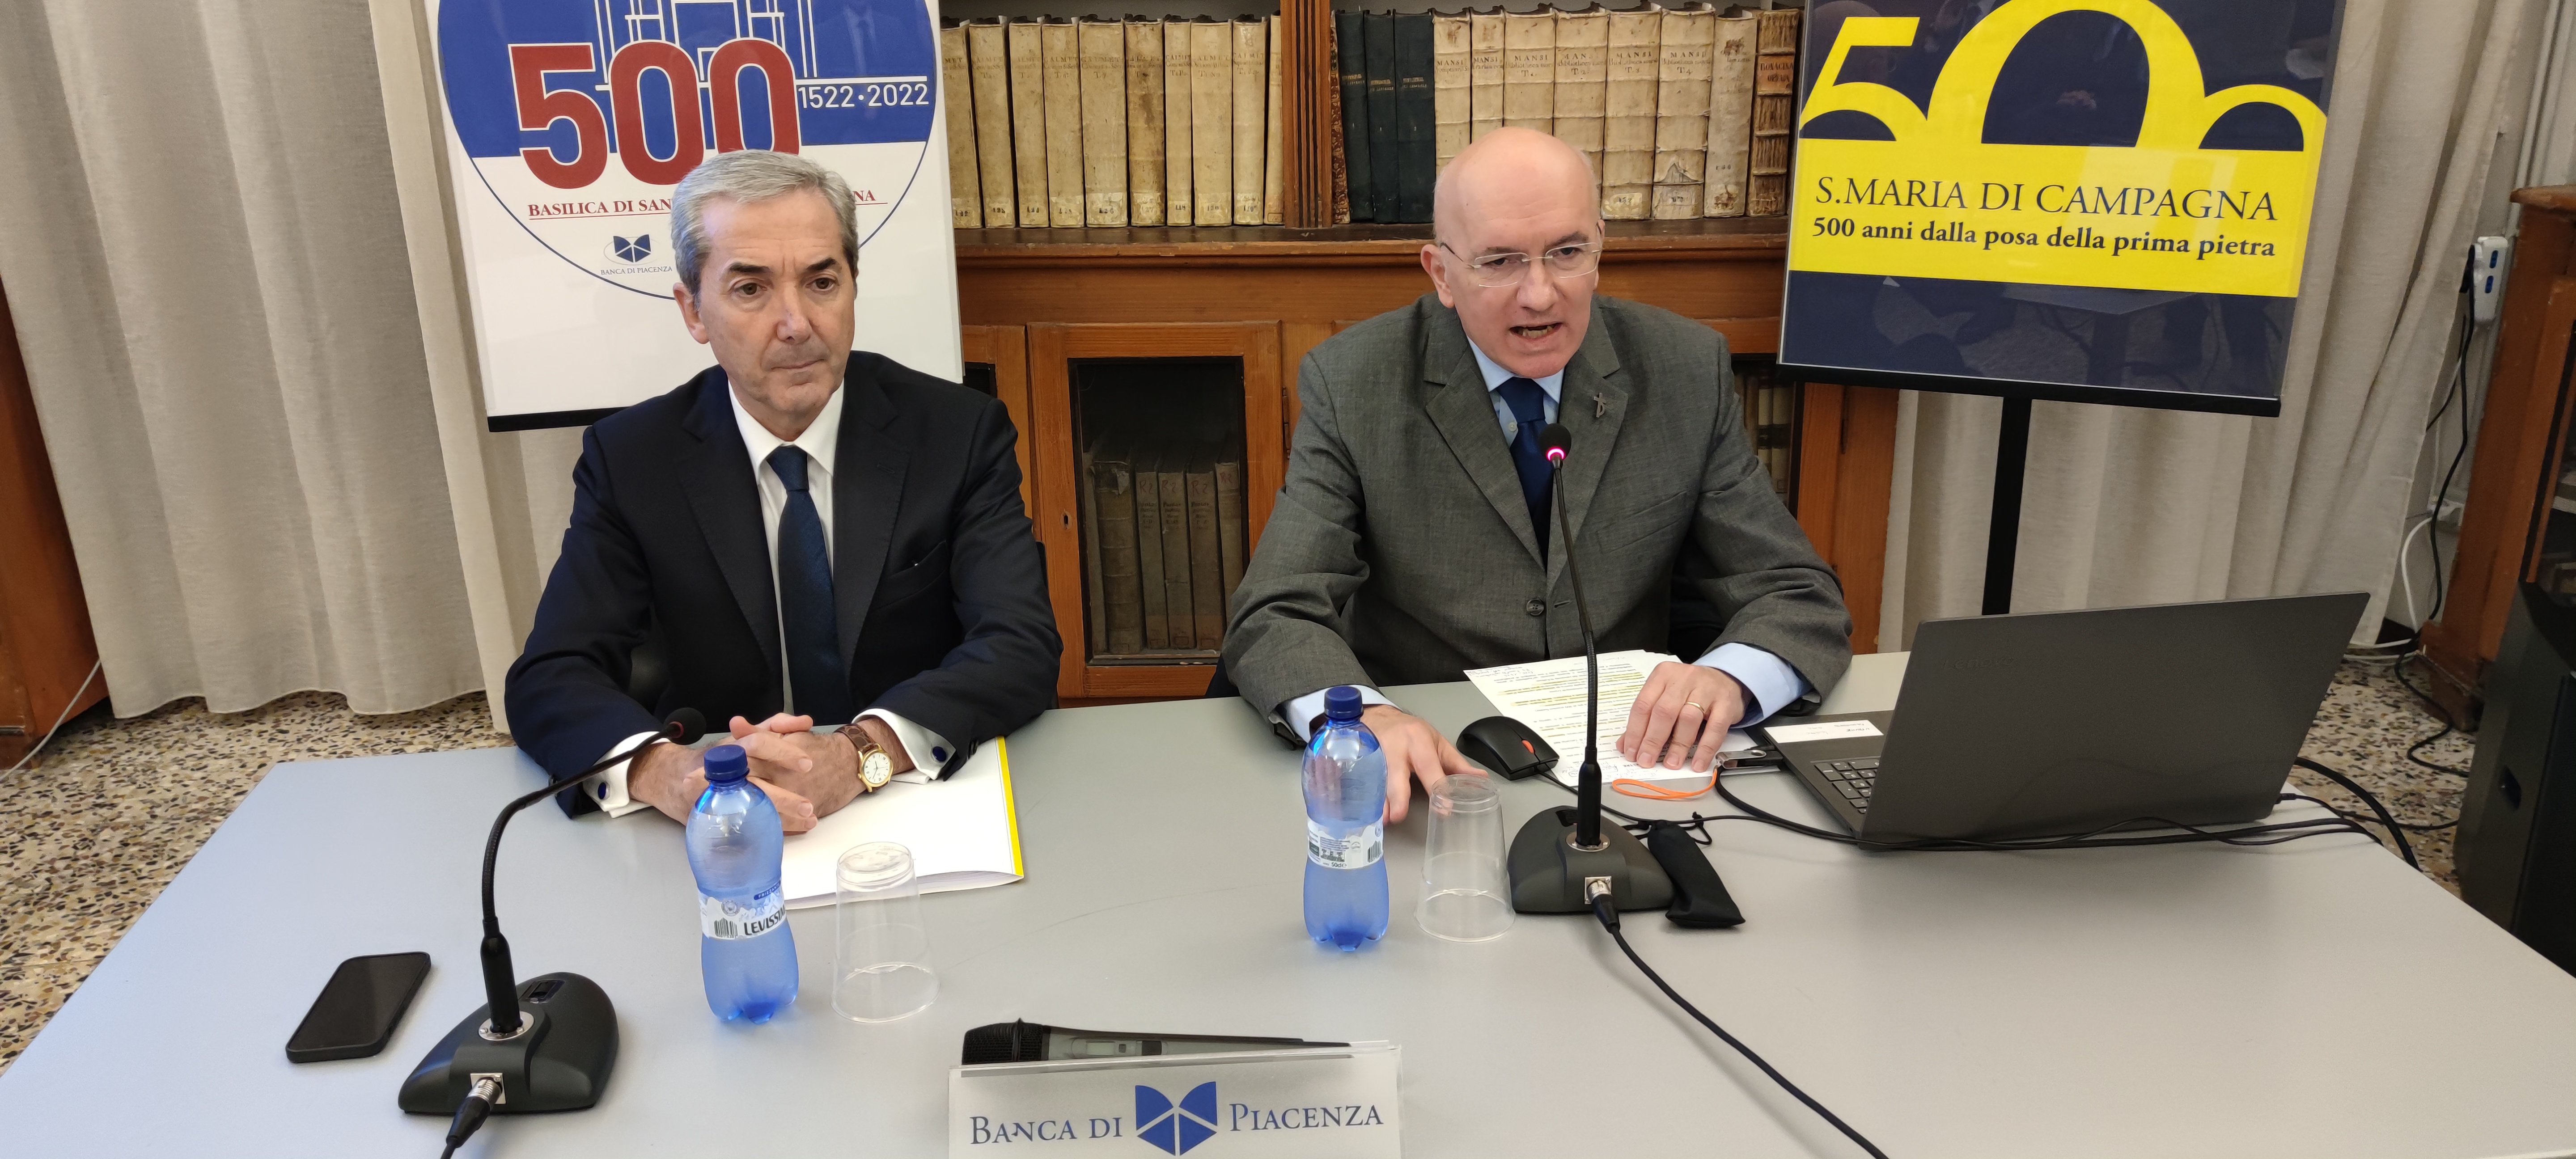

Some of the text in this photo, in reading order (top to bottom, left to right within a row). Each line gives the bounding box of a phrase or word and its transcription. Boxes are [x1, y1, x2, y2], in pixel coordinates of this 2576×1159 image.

[508, 38, 800, 189] 500
[528, 201, 608, 216] BASILICA
[613, 200, 634, 212] DI
[1980, 182, 2023, 211] DI
[2036, 184, 2278, 222] CAMPAGNA
[1812, 216, 2275, 260] 500 anni dalla posa della prima pietra
[970, 1103, 1383, 1145] BANCA DI PIACENZA
